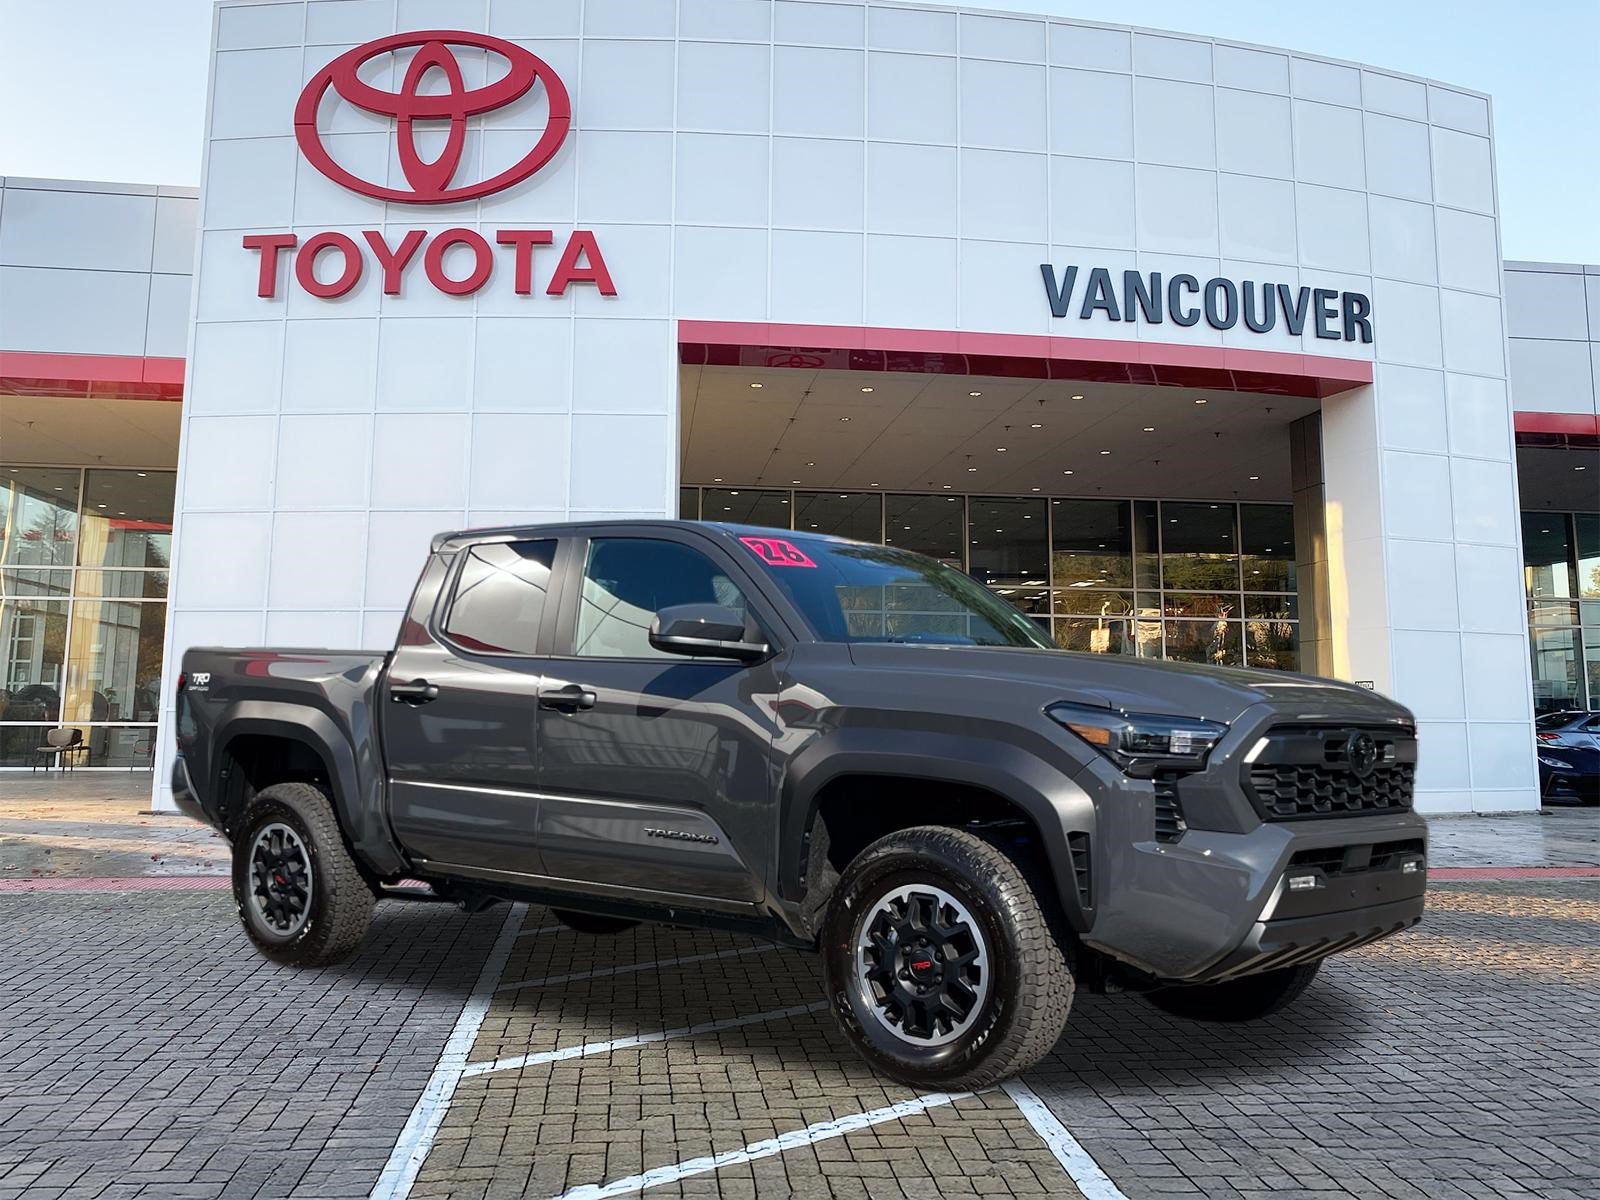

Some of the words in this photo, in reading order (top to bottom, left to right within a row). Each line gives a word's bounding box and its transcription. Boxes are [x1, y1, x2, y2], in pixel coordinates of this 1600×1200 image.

[243, 228, 618, 298] TOYOTA
[1040, 264, 1373, 343] VANCOUVER
[747, 539, 804, 562] 26
[644, 828, 720, 845] TACOMA
